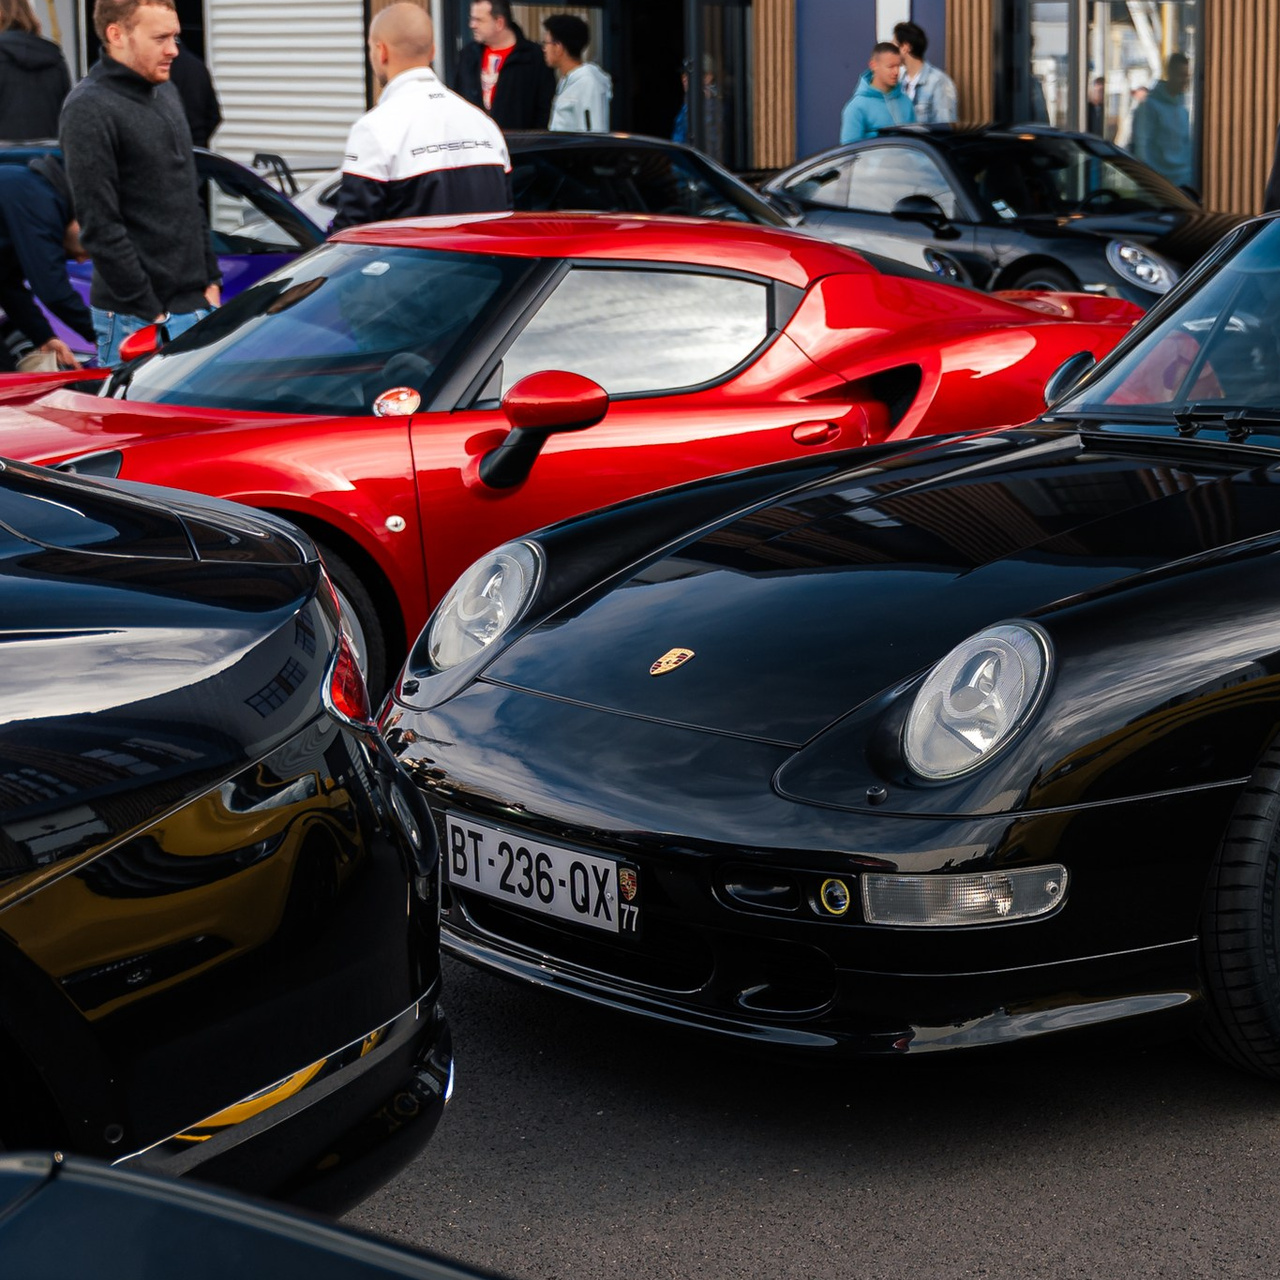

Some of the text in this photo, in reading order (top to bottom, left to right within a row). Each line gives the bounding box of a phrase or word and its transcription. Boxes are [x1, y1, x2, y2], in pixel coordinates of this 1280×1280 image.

[411, 140, 493, 157] PORSCHE
[450, 823, 613, 922] BT-236-QX
[620, 903, 639, 932] 77
[1262, 858, 1278, 975] MICHELIN
